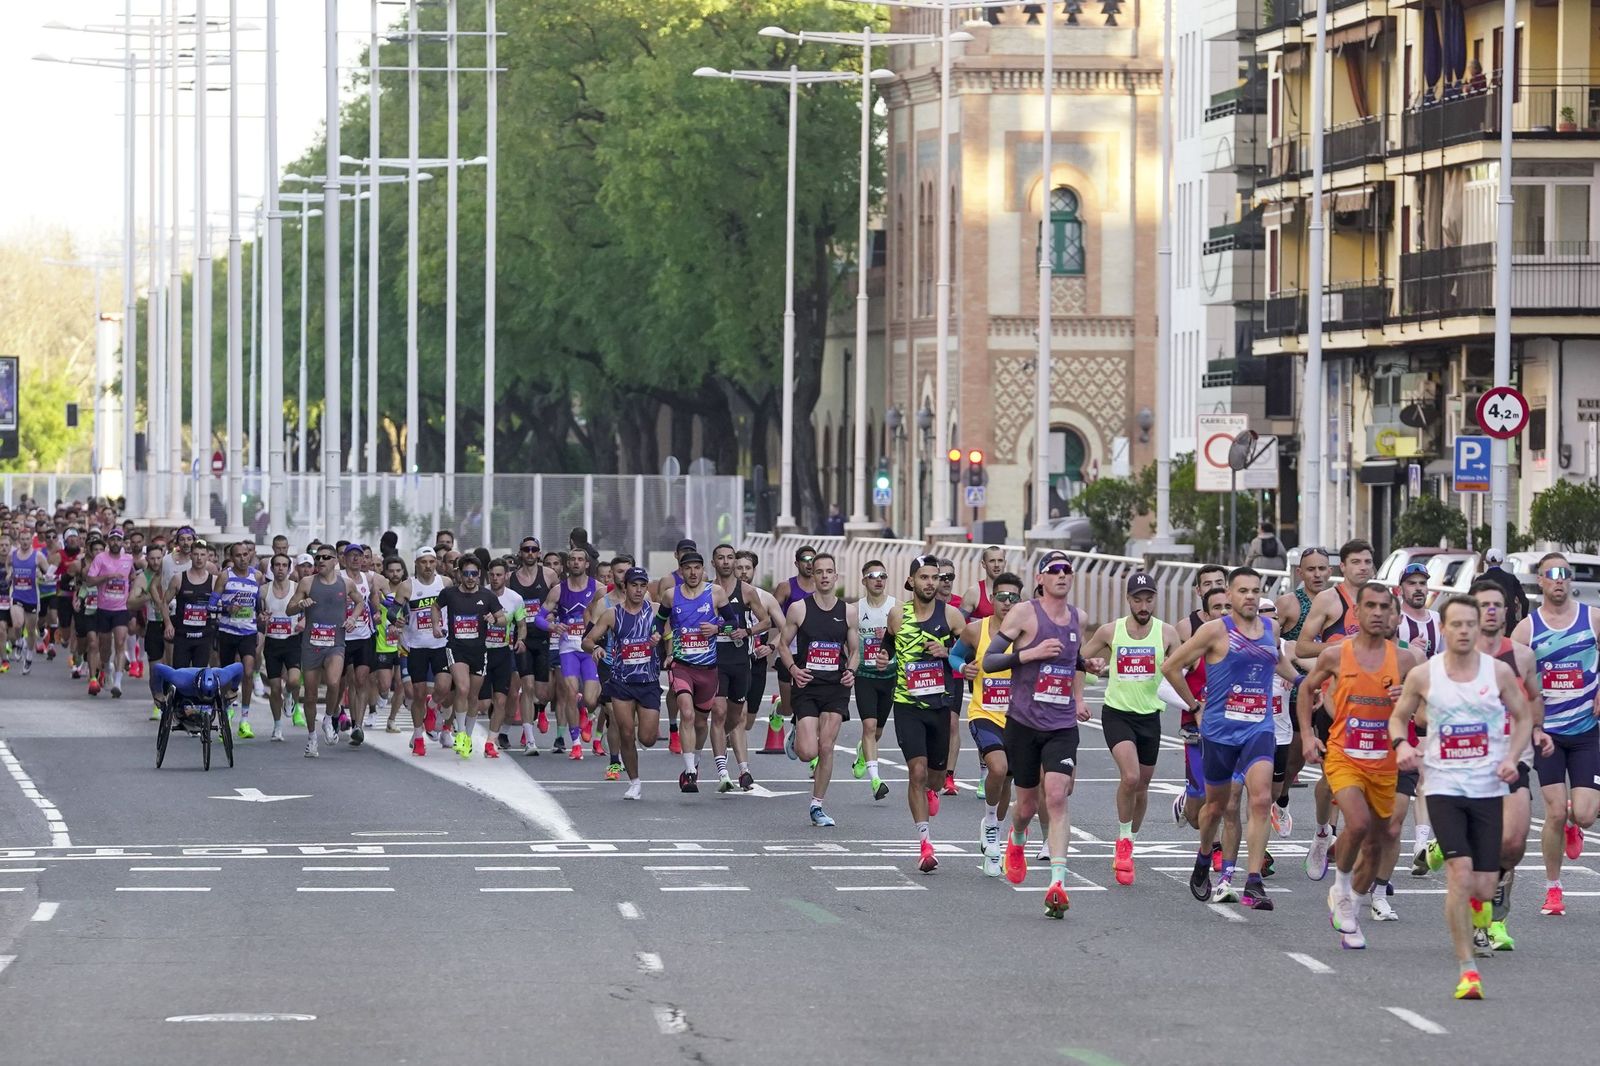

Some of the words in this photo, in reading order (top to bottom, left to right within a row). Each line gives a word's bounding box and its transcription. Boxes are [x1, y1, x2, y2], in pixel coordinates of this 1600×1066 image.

[1460, 442, 1482, 470] P
[628, 650, 646, 659] JORGE
[811, 656, 836, 664] VINCENT
[1124, 665, 1148, 673] KAROL
[1551, 680, 1574, 689] MARK
[1047, 685, 1063, 695] MIKE
[1225, 705, 1246, 713] DAVID
[1455, 725, 1482, 733] ZURICH
[1359, 740, 1374, 749] RUI
[1444, 746, 1484, 758] THOMAS
